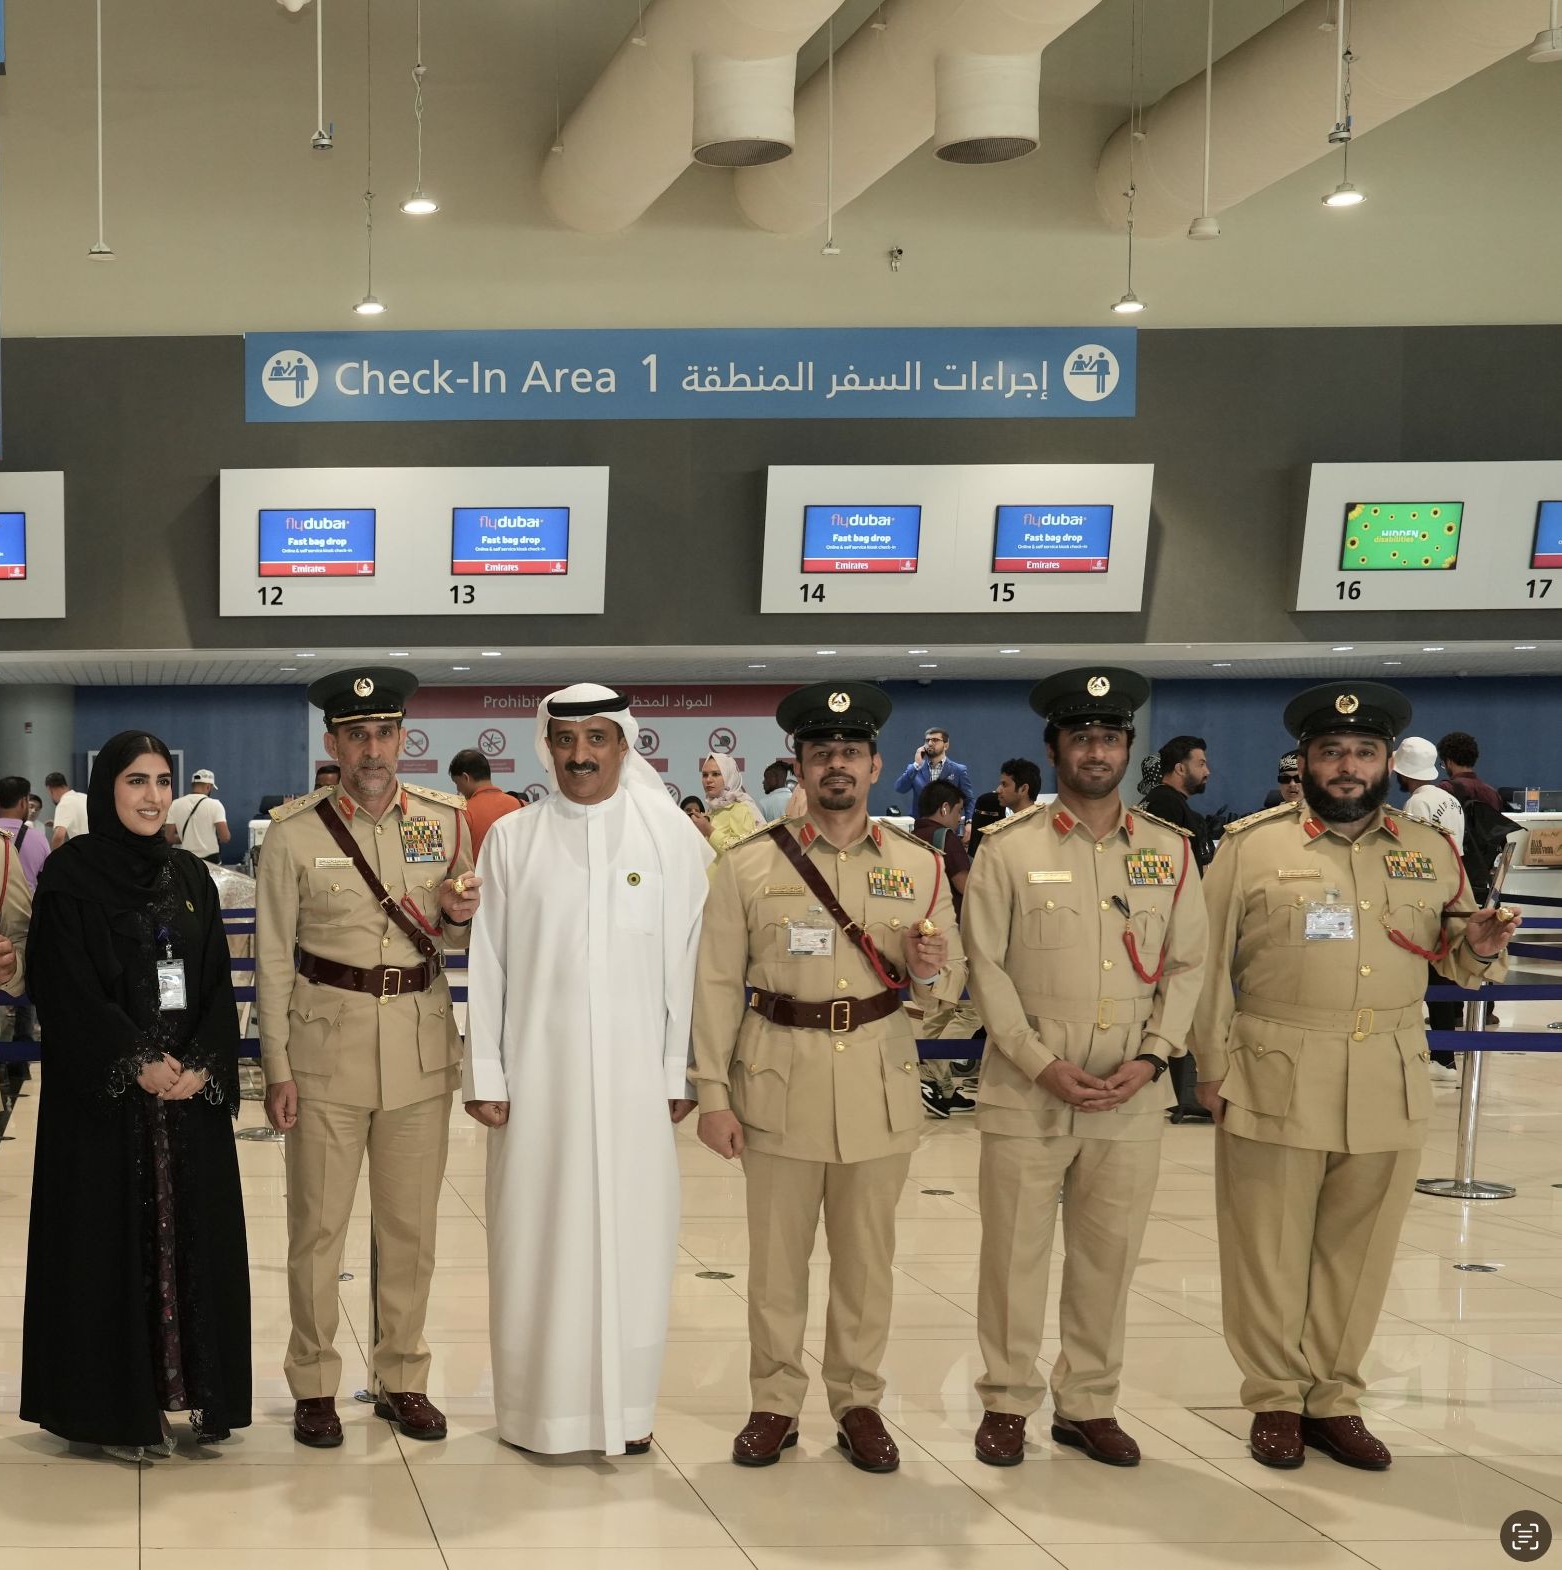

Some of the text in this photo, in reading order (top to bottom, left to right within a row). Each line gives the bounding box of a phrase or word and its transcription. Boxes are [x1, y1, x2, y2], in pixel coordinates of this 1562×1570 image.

[334, 355, 659, 397] Check-In Area 1
[683, 360, 1048, 400] إجراءات السفر المنطقة
[286, 518, 347, 531] flydubai
[479, 516, 541, 530] flydubai
[831, 514, 892, 528] flydubai
[1023, 514, 1084, 527] flydubai
[309, 538, 324, 546] bag
[326, 538, 346, 546] drop
[482, 536, 540, 545] Fast bag drop
[833, 534, 891, 543] Fast bag drop
[1046, 534, 1061, 542] bag
[1063, 534, 1082, 542] drop
[258, 587, 283, 605] 12
[450, 585, 474, 604] 13
[800, 584, 825, 602] 14
[990, 583, 1014, 602] 15
[1336, 581, 1361, 600] 16
[1526, 580, 1552, 598] 17
[484, 695, 541, 708] Prohibit
[674, 695, 712, 710] المواد
